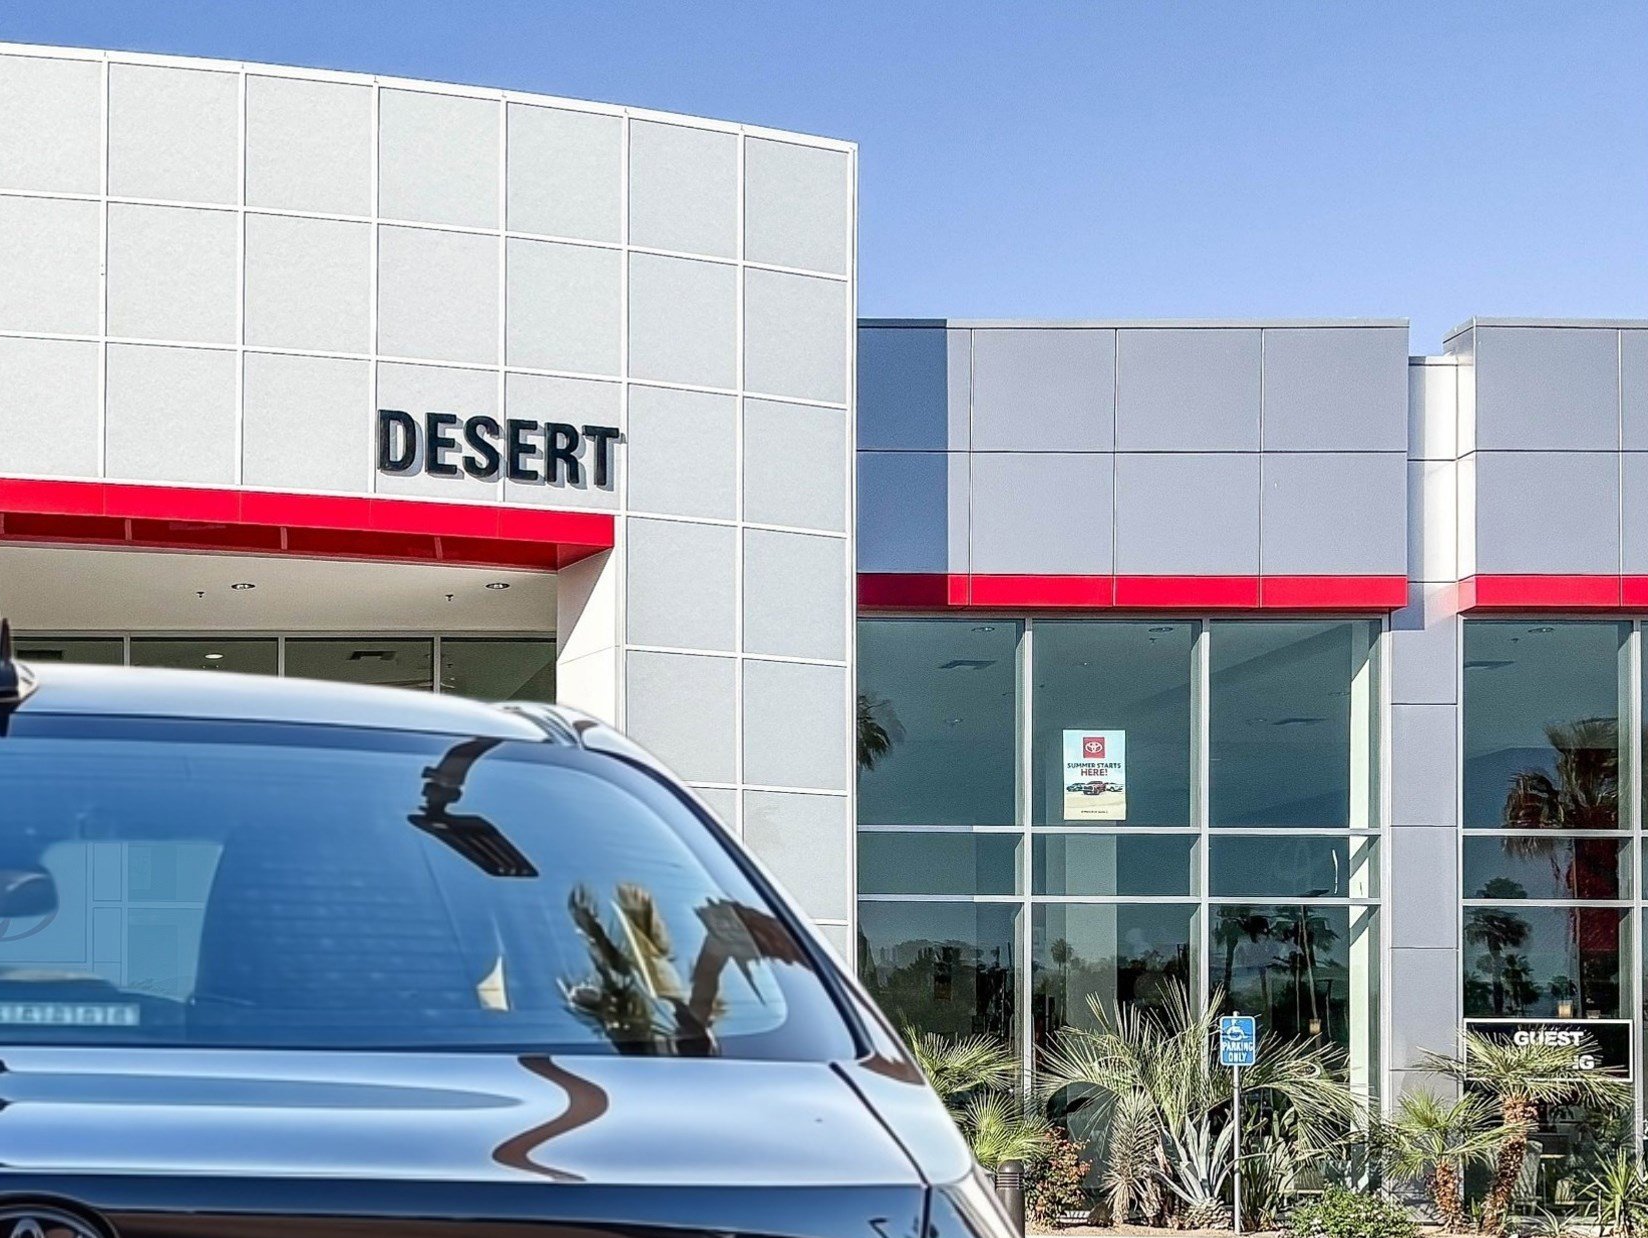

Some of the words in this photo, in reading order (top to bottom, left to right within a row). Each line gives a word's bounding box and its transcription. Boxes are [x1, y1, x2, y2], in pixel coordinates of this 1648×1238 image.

[377, 409, 620, 486] DESERT
[1081, 768, 1108, 776] HERE!
[1513, 1031, 1584, 1046] GUEST
[1222, 1041, 1254, 1051] PARKING
[1228, 1051, 1248, 1062] ONLY
